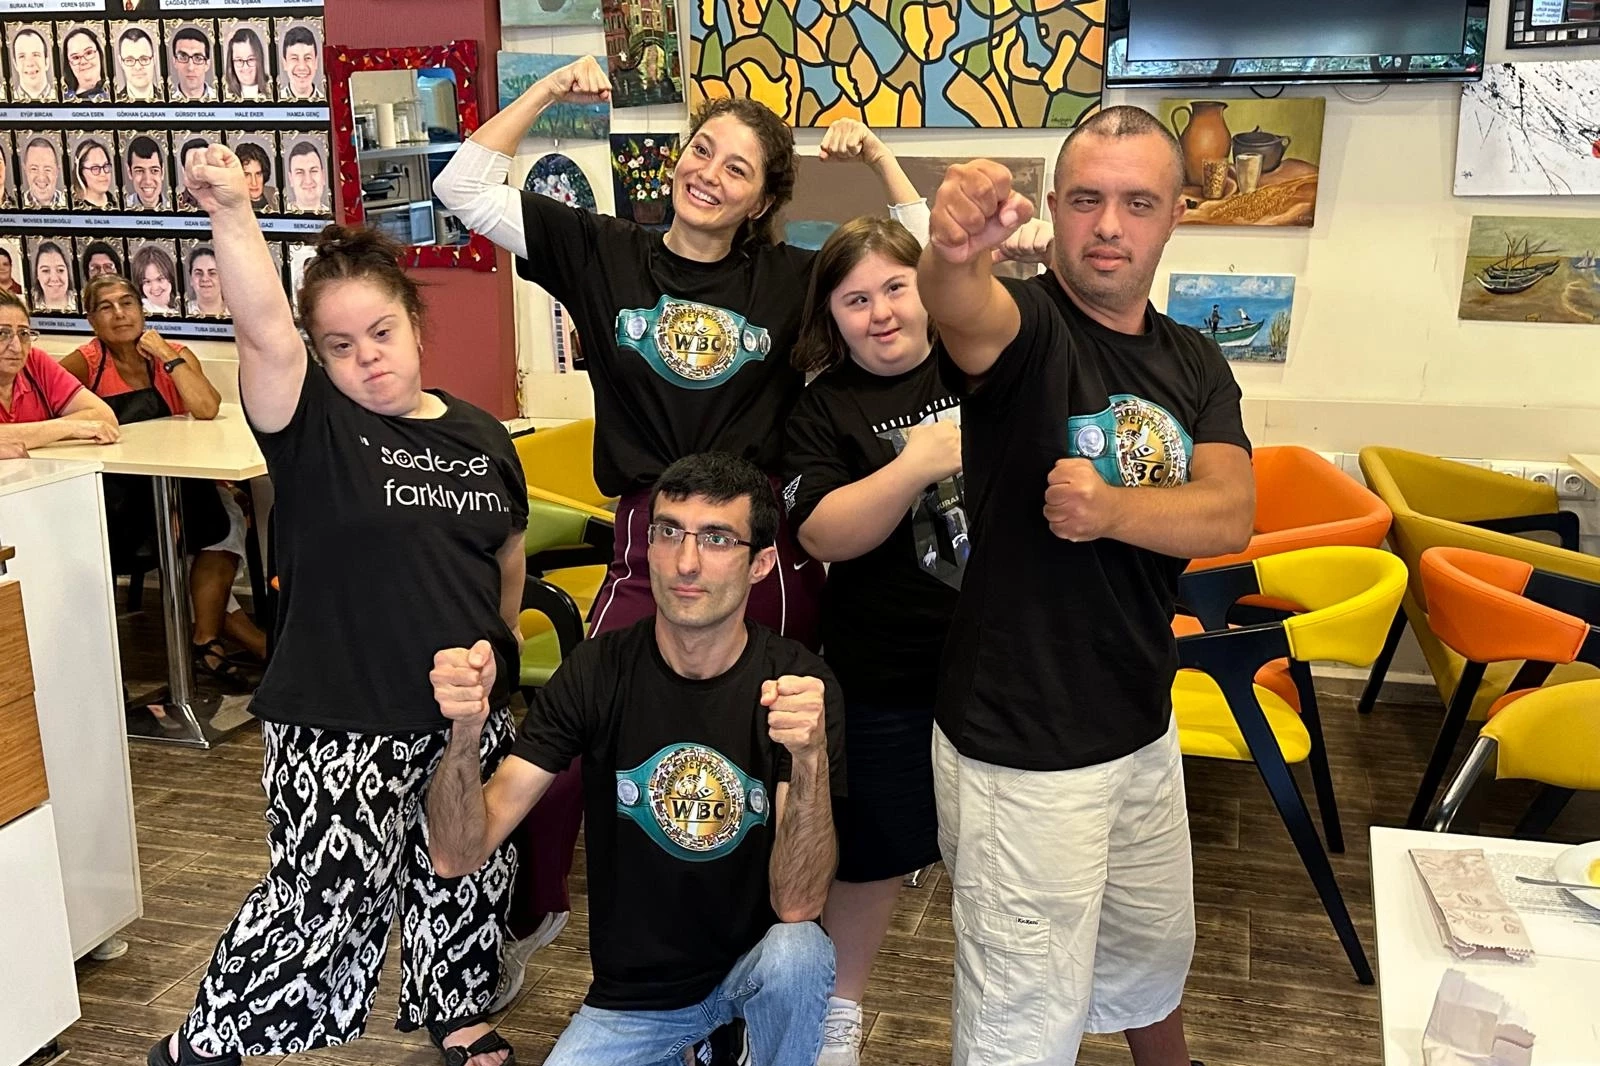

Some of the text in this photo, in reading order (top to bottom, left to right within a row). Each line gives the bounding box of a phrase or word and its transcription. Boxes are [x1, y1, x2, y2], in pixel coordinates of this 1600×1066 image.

[674, 334, 722, 352] WBC
[665, 761, 731, 800] WORLD CHAMPION
[672, 800, 725, 820] WBC
